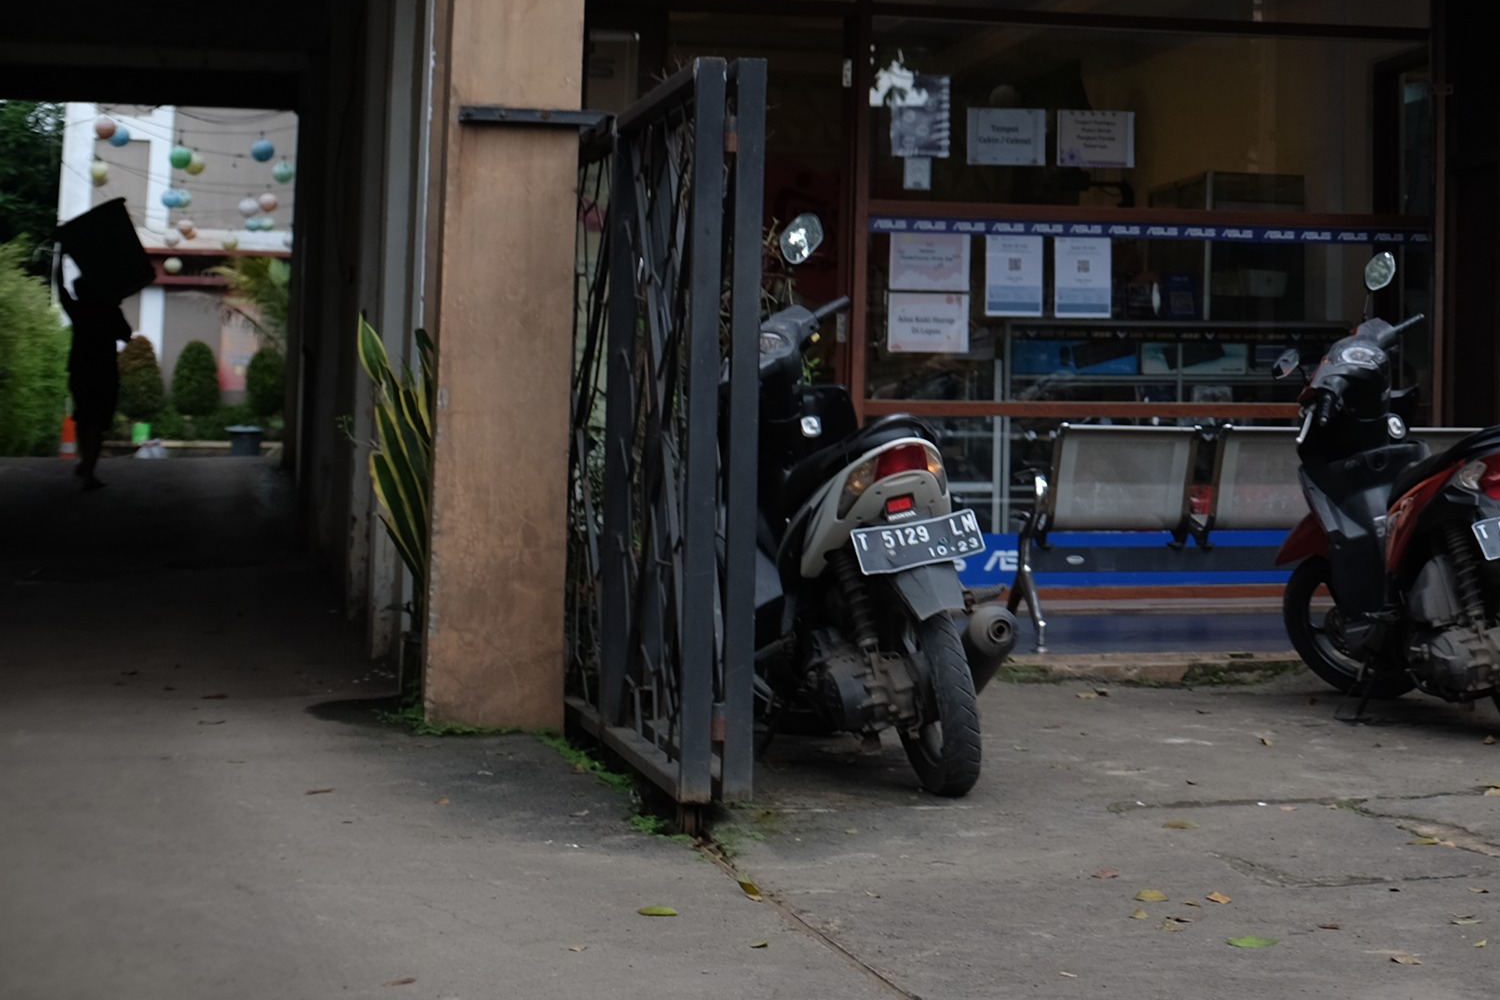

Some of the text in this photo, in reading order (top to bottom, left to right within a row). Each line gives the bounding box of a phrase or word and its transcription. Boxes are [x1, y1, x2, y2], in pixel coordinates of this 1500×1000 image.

[856, 513, 977, 552] T 5129 LN
[1476, 524, 1489, 539] T
